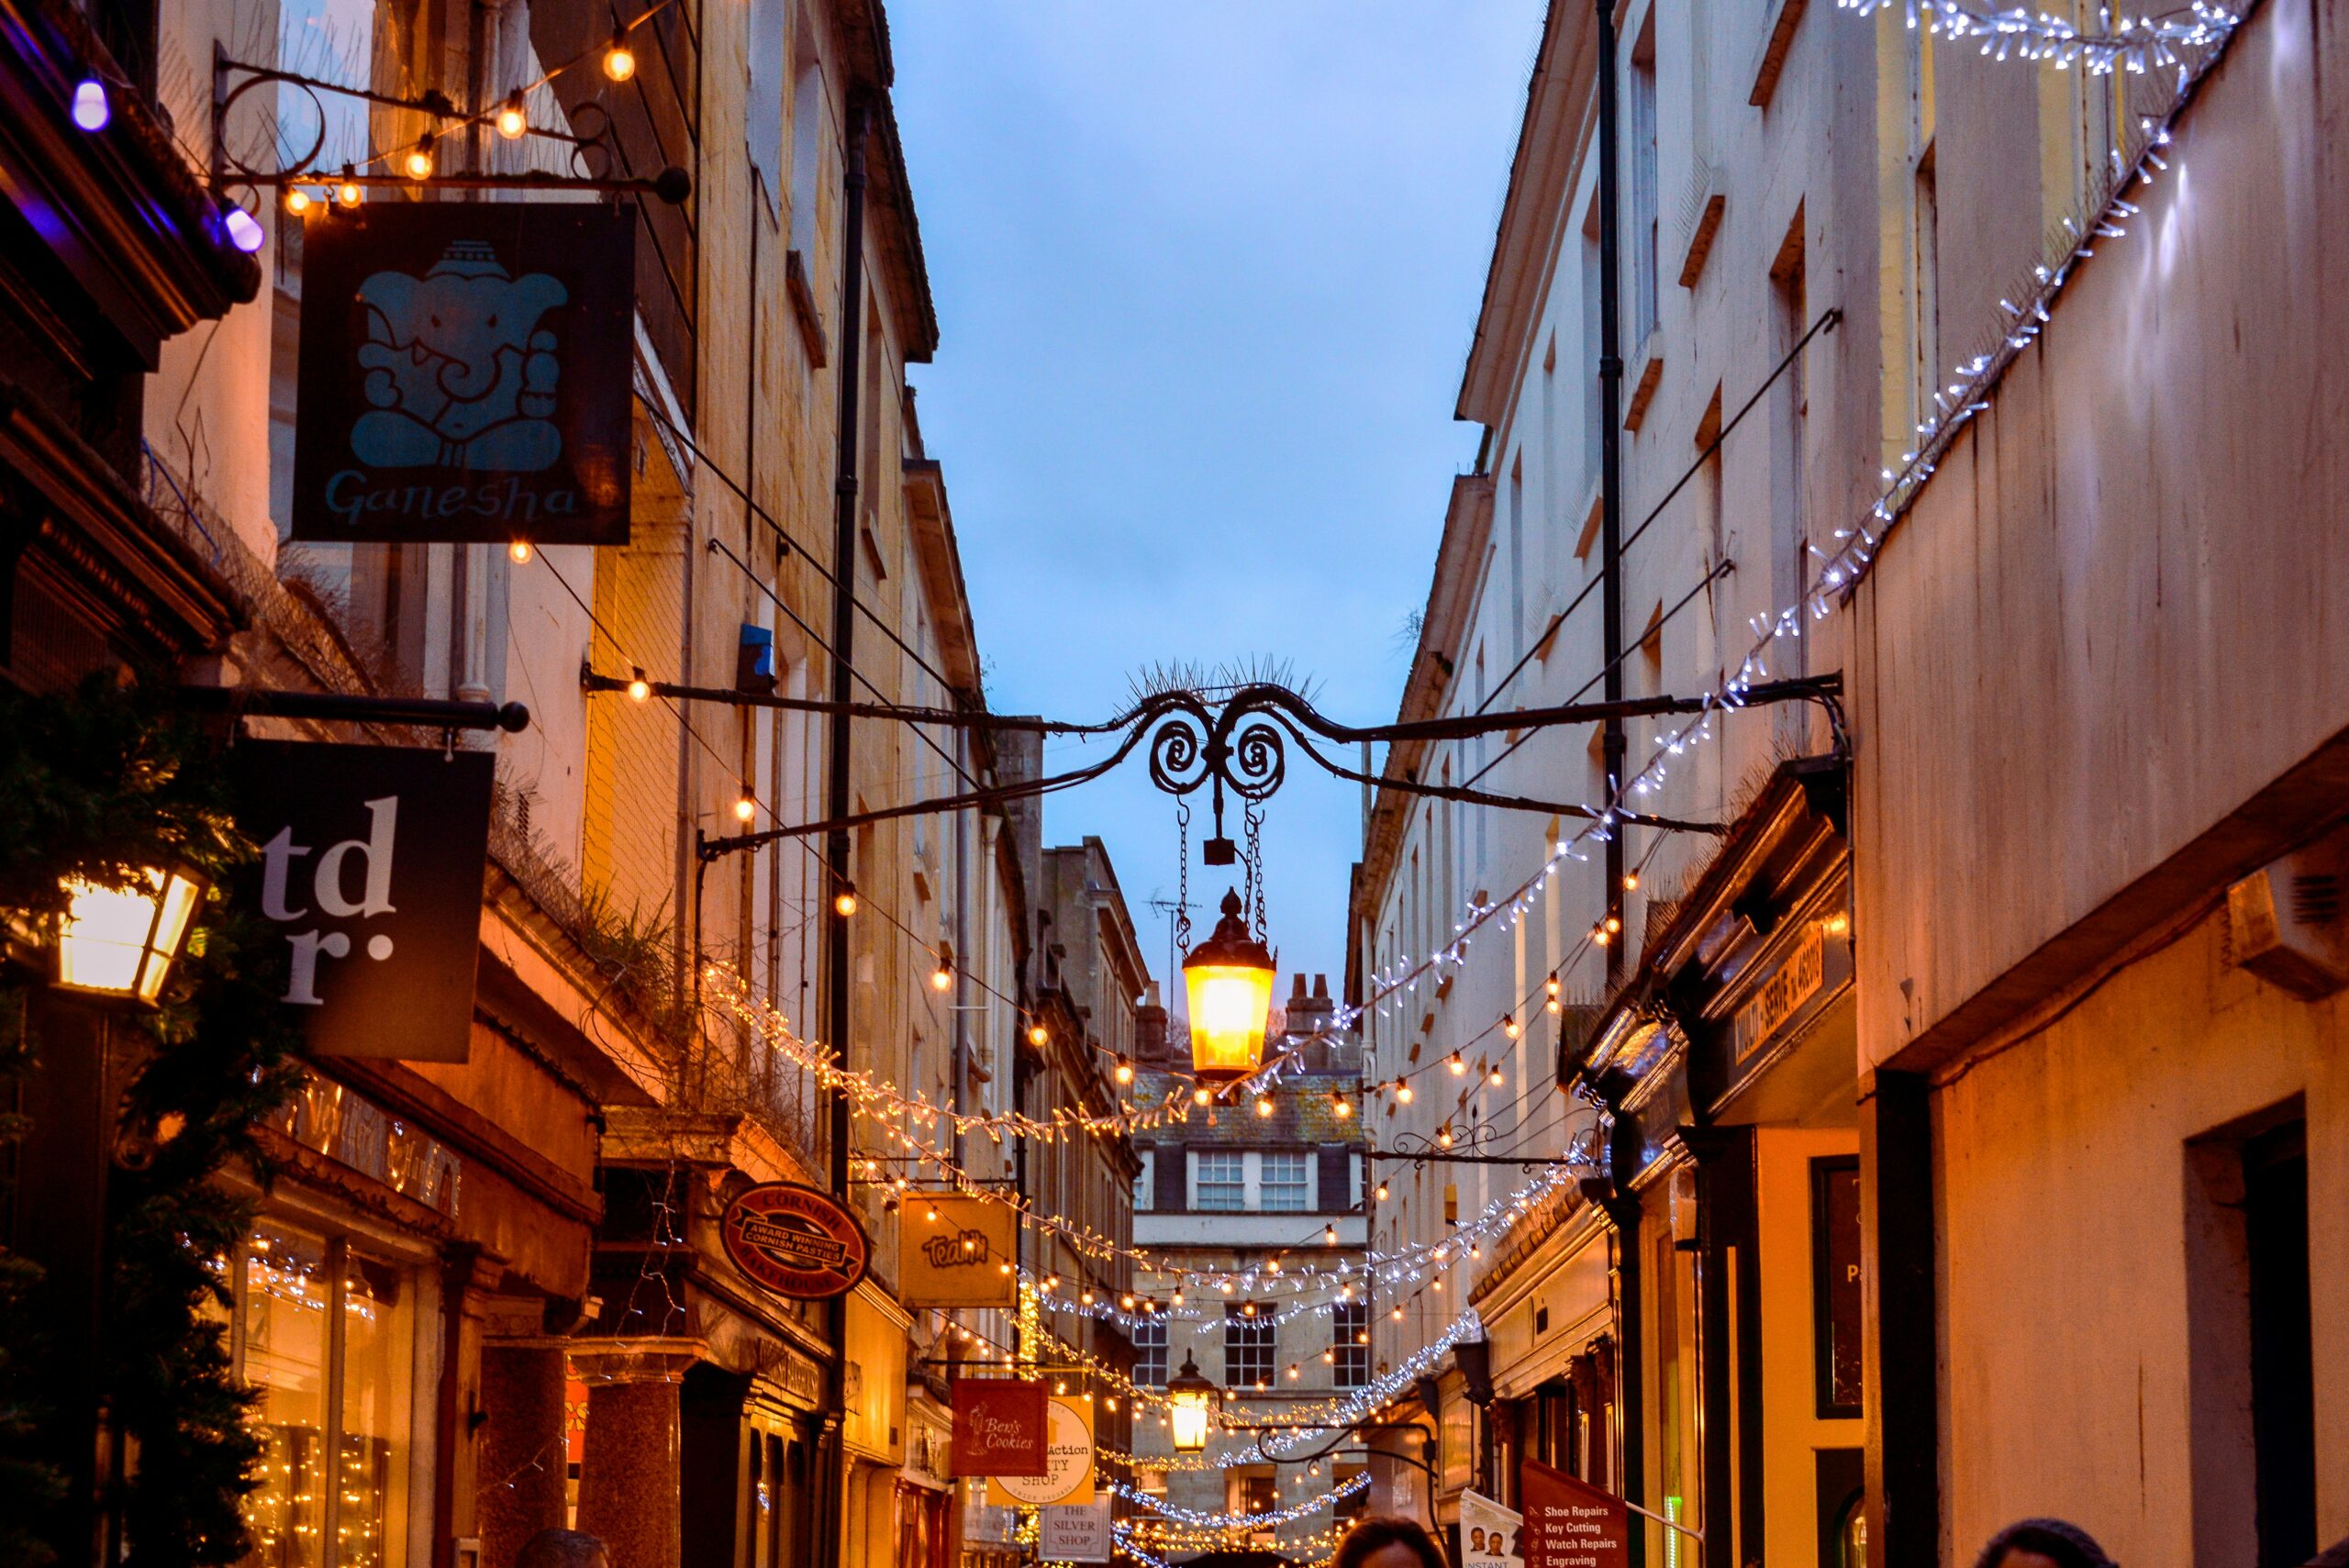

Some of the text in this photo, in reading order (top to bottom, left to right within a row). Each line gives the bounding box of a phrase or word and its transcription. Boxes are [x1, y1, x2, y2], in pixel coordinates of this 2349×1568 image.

[325, 470, 579, 525] Ganesha
[261, 795, 398, 920] td
[1765, 969, 1787, 1031] SERVE
[763, 1194, 842, 1231] CORNISH
[751, 1224, 840, 1252] AWARD WINNING
[745, 1231, 841, 1261] CORNISH PASTIES
[740, 1245, 833, 1288] BAKEHOUSE
[985, 1418, 1021, 1434] Ben's
[986, 1433, 1034, 1450] Cookies
[1048, 1445, 1089, 1455] Action
[1022, 1474, 1059, 1486] SHOP
[1063, 1506, 1087, 1515] THE
[1545, 1506, 1609, 1518] Shoe Repairs
[1054, 1519, 1096, 1530] SILVER
[1545, 1522, 1601, 1535] Key Cutting
[1059, 1534, 1091, 1546] SHOP
[1545, 1539, 1617, 1551] Watch Repairs
[1546, 1555, 1597, 1568] Engraving
